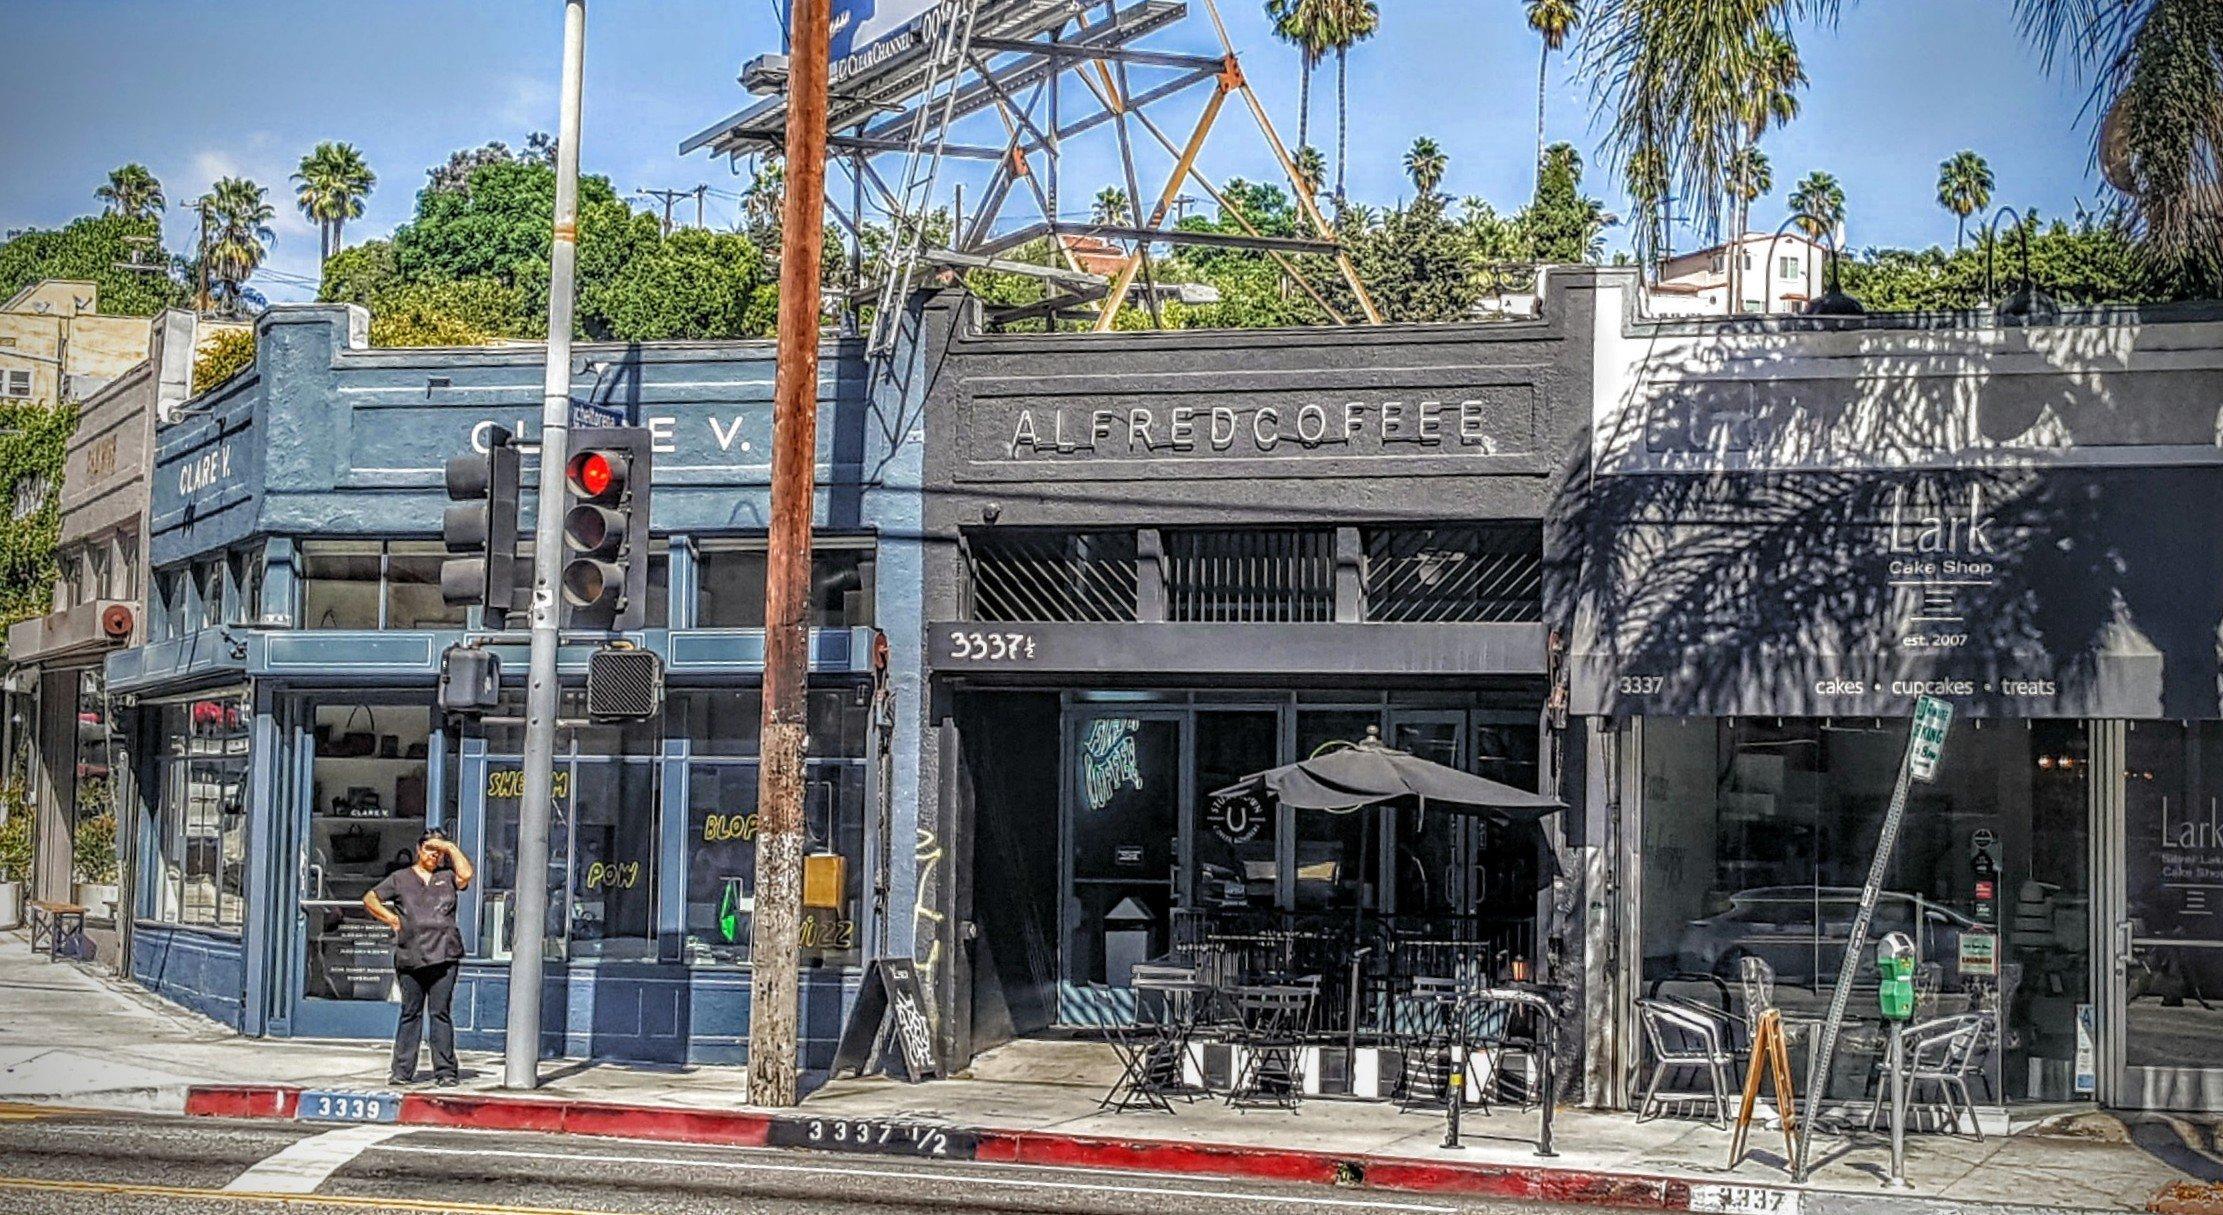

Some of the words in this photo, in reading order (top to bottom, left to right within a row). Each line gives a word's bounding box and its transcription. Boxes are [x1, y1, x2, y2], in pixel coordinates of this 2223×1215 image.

[471, 417, 676, 453] CLE
[708, 417, 751, 452] V.
[180, 451, 218, 495] CLARE
[222, 445, 231, 478] V.
[1889, 483, 1996, 555] Lark
[1889, 561, 1936, 575] Cake
[1943, 560, 1994, 577] Shop
[1903, 636, 1929, 647] est.
[1932, 634, 1968, 647] 2007
[1620, 677, 1664, 694] 3337
[1816, 677, 1864, 695] cakes
[1892, 676, 1974, 699] cupcakes
[2000, 678, 2056, 696] treats
[488, 770, 568, 798] SHEM
[704, 814, 759, 840] BLOP
[2162, 796, 2223, 848] Lark
[588, 861, 639, 888] POW
[318, 1097, 380, 1119] 3339
[809, 1120, 892, 1144] 3337
[912, 1127, 947, 1154] 1/2
[1720, 1187, 1786, 1211] 3337
